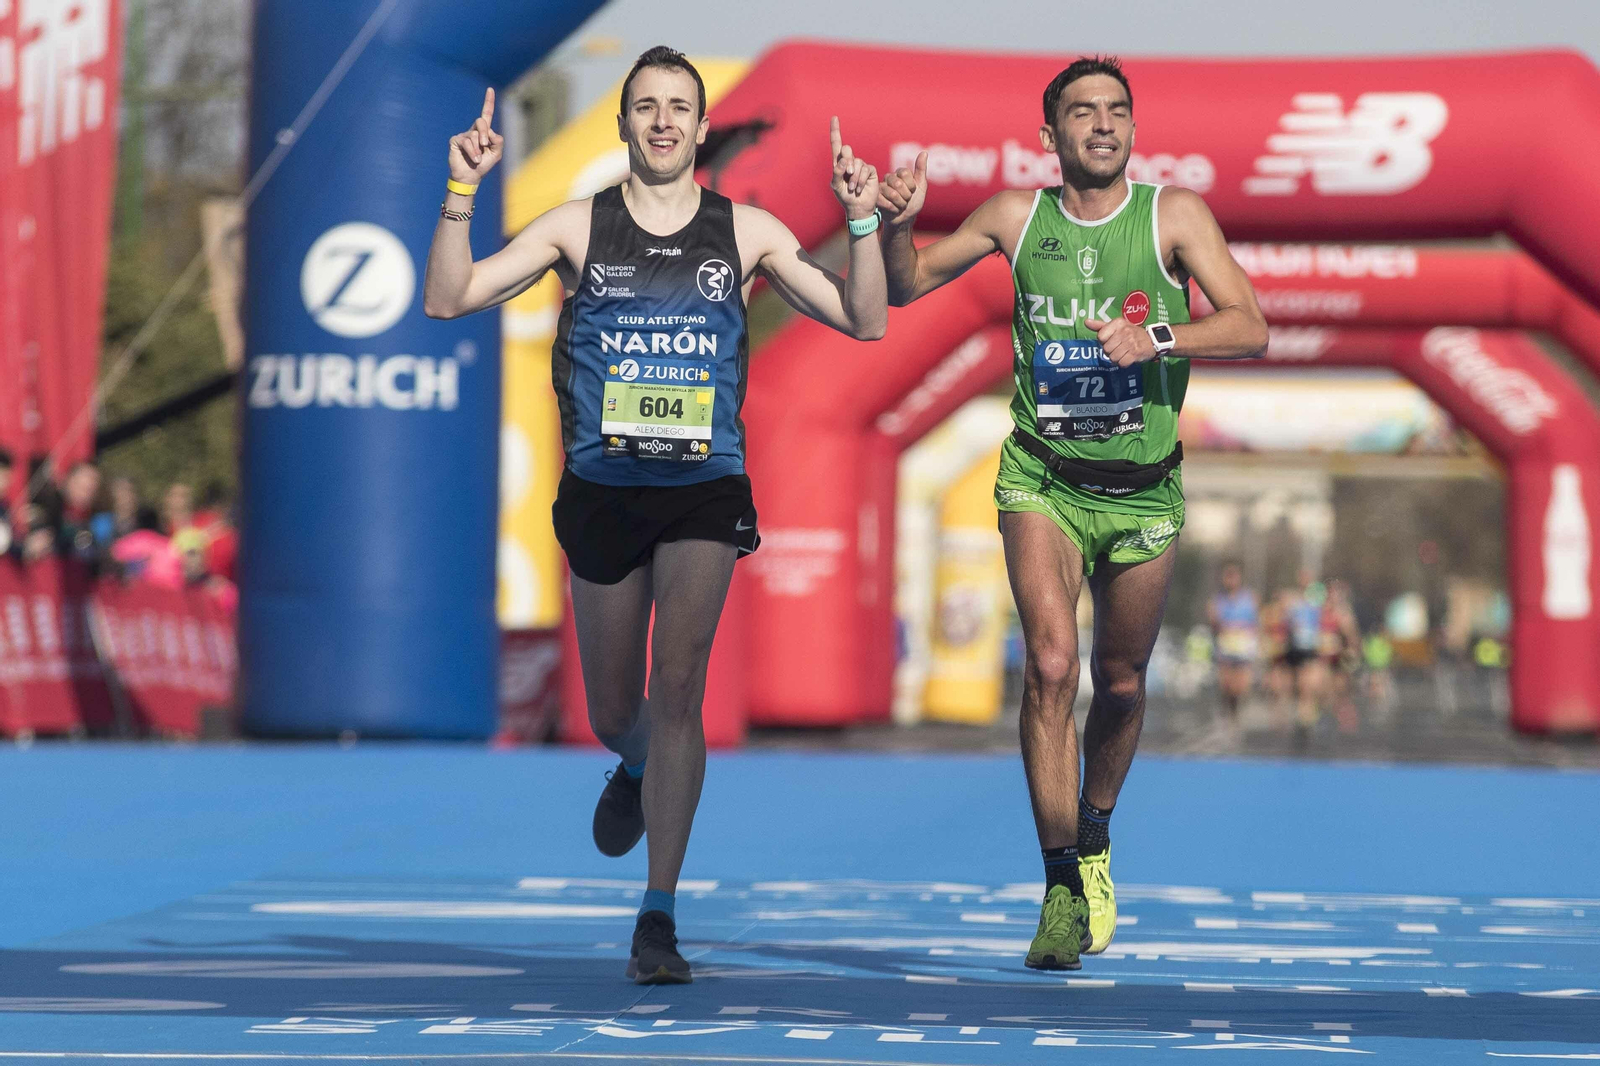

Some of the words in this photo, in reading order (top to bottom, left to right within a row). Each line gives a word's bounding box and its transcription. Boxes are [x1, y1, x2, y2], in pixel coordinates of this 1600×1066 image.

[1031, 252, 1068, 262] HYUNDAI
[617, 315, 644, 325] CLUB
[646, 315, 706, 325] ATLETISMO
[600, 326, 717, 357] NARÓN
[642, 365, 704, 381] ZURICH
[249, 353, 460, 412] ZURICH
[1075, 376, 1106, 398] 72
[639, 396, 684, 419] 604
[1076, 405, 1108, 414] BLANDO
[634, 426, 656, 435] ALEX
[657, 426, 685, 436] DIEGO
[1111, 422, 1139, 434] ZURICH
[682, 453, 708, 461] ZURICH
